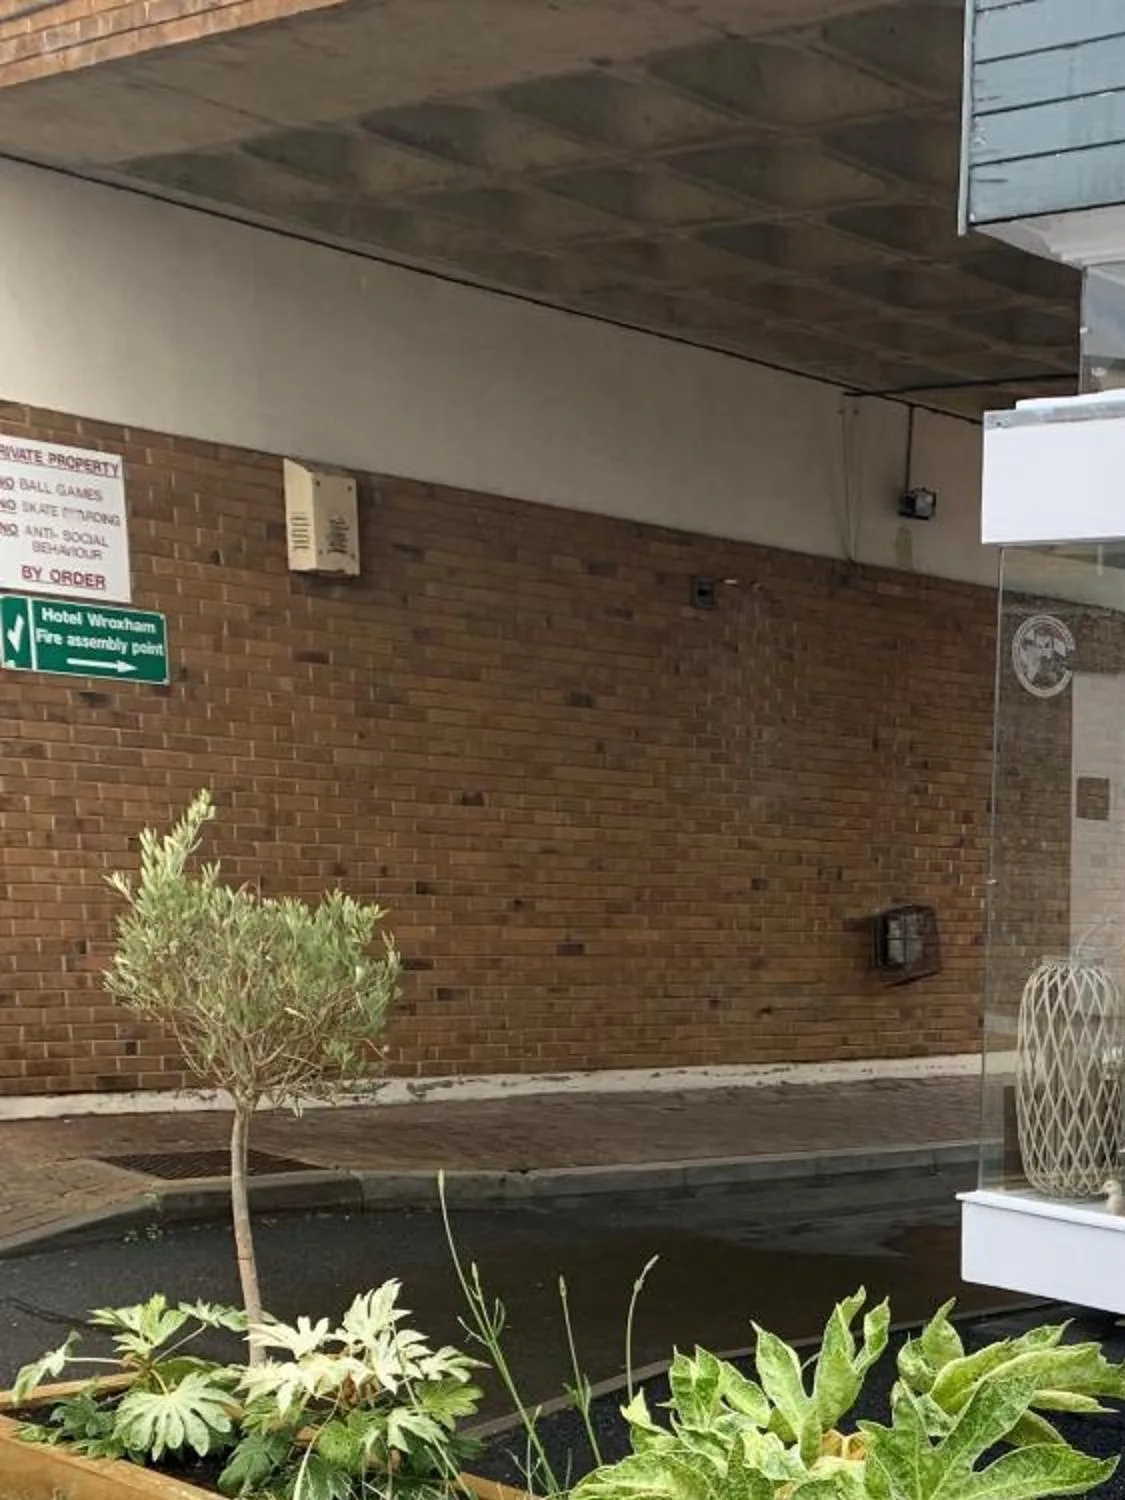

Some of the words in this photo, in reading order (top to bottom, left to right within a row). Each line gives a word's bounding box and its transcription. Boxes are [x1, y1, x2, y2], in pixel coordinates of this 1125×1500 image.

[48, 452, 119, 477] PROPERTY
[20, 478, 52, 494] BALL
[56, 483, 103, 501] GAMES
[22, 501, 59, 517] SKATE
[32, 541, 102, 560] BEHAVIOUR
[63, 529, 108, 548] SOCIAL
[22, 565, 42, 580] BY
[50, 569, 106, 590] ORDER
[41, 608, 82, 625] Hotel
[87, 612, 156, 633] Wroxham
[36, 628, 63, 645] Fire
[67, 634, 128, 654] assembly
[131, 640, 164, 656] point
